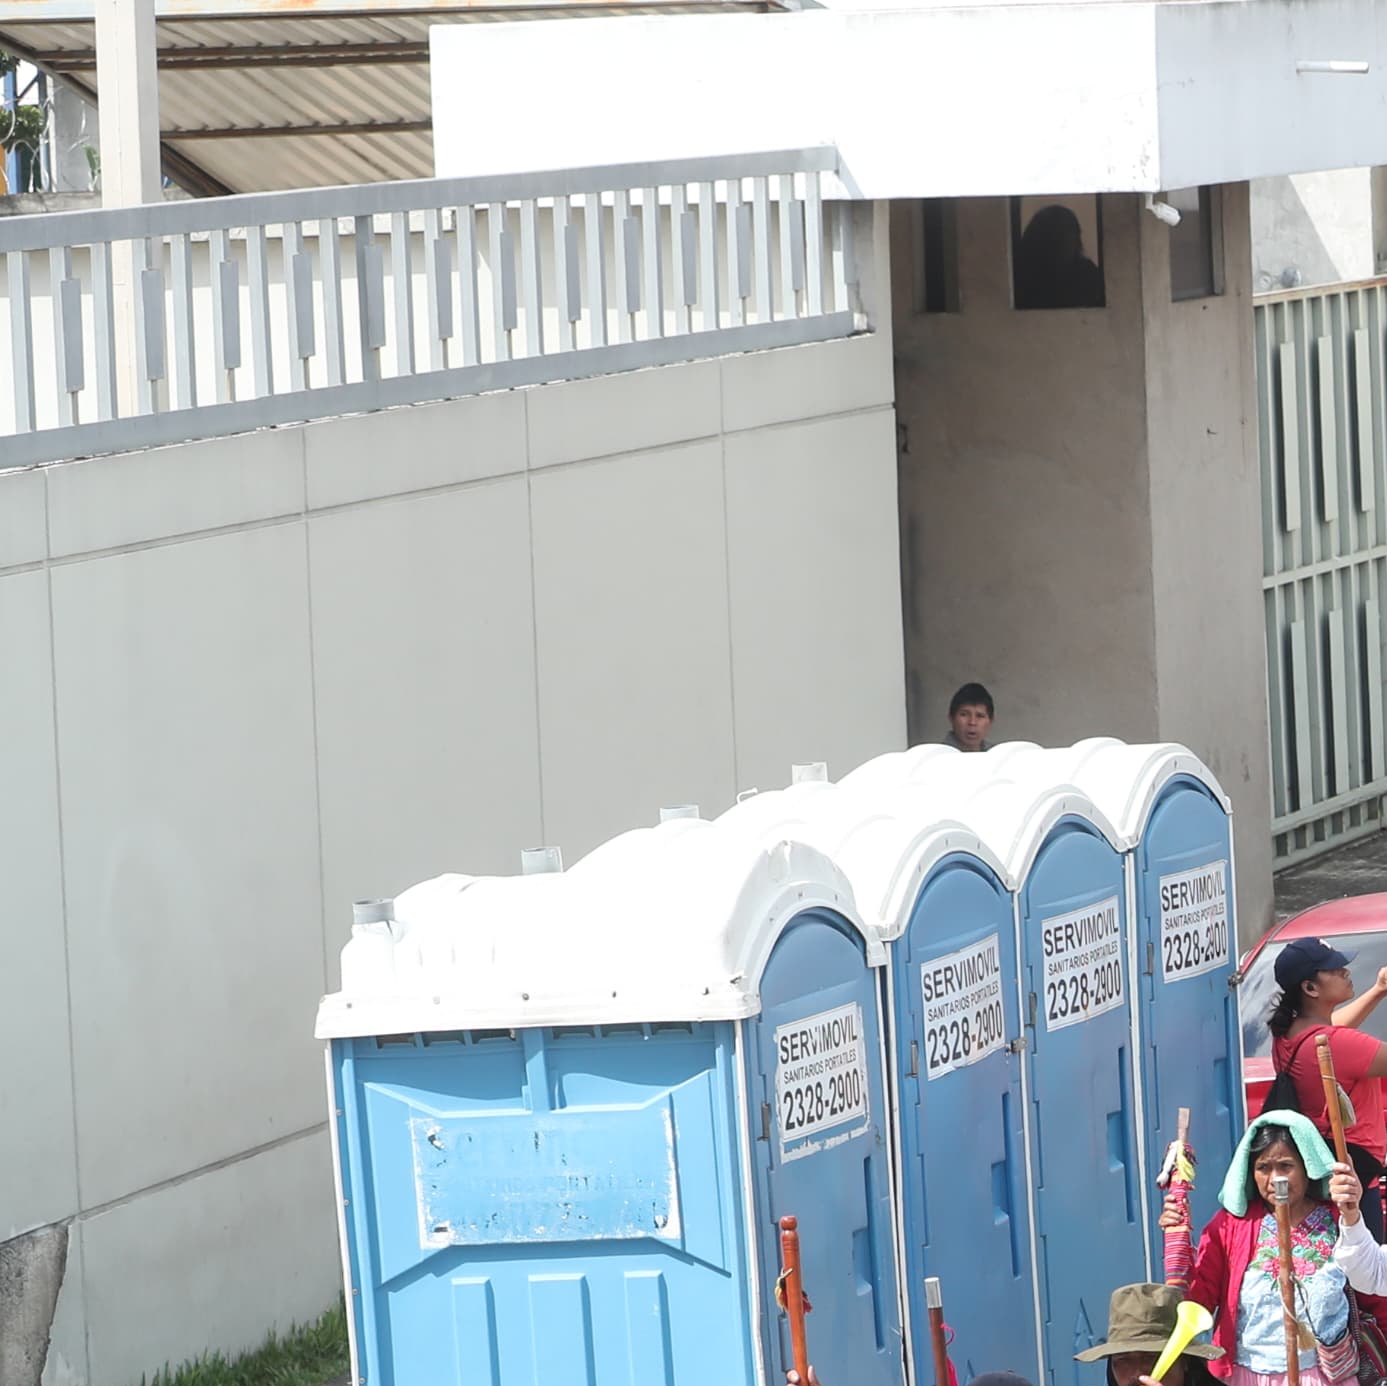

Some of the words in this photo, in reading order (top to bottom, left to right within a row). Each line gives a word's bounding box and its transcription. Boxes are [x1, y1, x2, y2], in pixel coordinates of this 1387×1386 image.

[1161, 871, 1225, 912] SERVIMOVIL
[1043, 907, 1119, 957] SERVIMOVIL
[1164, 910, 1200, 931] SANITARIOS
[1048, 951, 1089, 976] SANITARIOS
[1164, 920, 1227, 973] 2328-2900
[923, 946, 999, 1002] SERVIMOVIL
[1047, 959, 1121, 1021] 2328-2900
[927, 995, 969, 1022] SANITARIOS
[780, 1014, 857, 1064] SERVIMOVIL
[927, 1000, 1003, 1070] 2328-2900
[783, 1060, 824, 1084] SANITARIOS
[783, 1068, 861, 1131] 2328-2900
